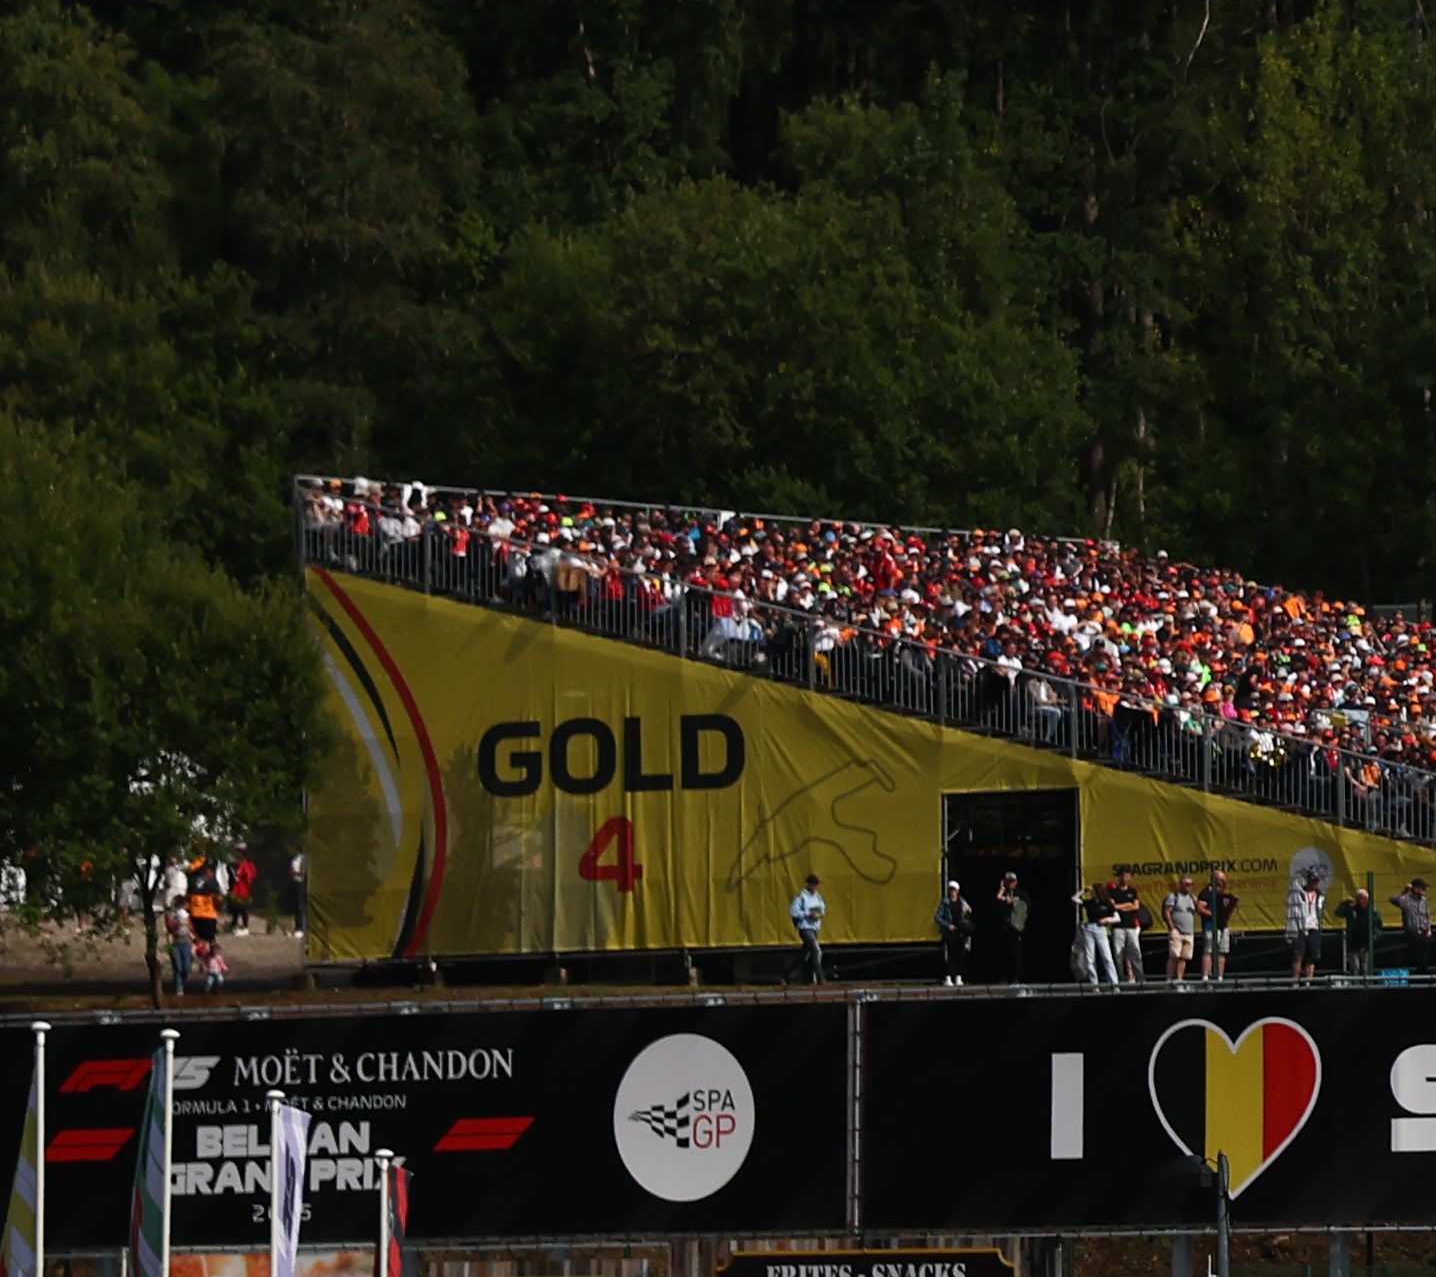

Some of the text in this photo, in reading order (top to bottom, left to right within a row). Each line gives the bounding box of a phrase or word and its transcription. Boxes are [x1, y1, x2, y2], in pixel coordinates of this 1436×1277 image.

[477, 713, 745, 797] GOLD
[578, 816, 643, 893] 4
[233, 1048, 513, 1086] MOËT & CHANDON
[172, 1100, 238, 1116] ORMULA
[243, 1099, 250, 1113] 1
[313, 1096, 324, 1110] &
[328, 1094, 407, 1111] CHANDON
[693, 1089, 735, 1112] SPA
[1051, 1052, 1084, 1160] I
[196, 1120, 370, 1158] BELAN
[693, 1114, 736, 1149] GP
[171, 1160, 272, 1196] GRAN
[252, 1204, 311, 1223] 25
